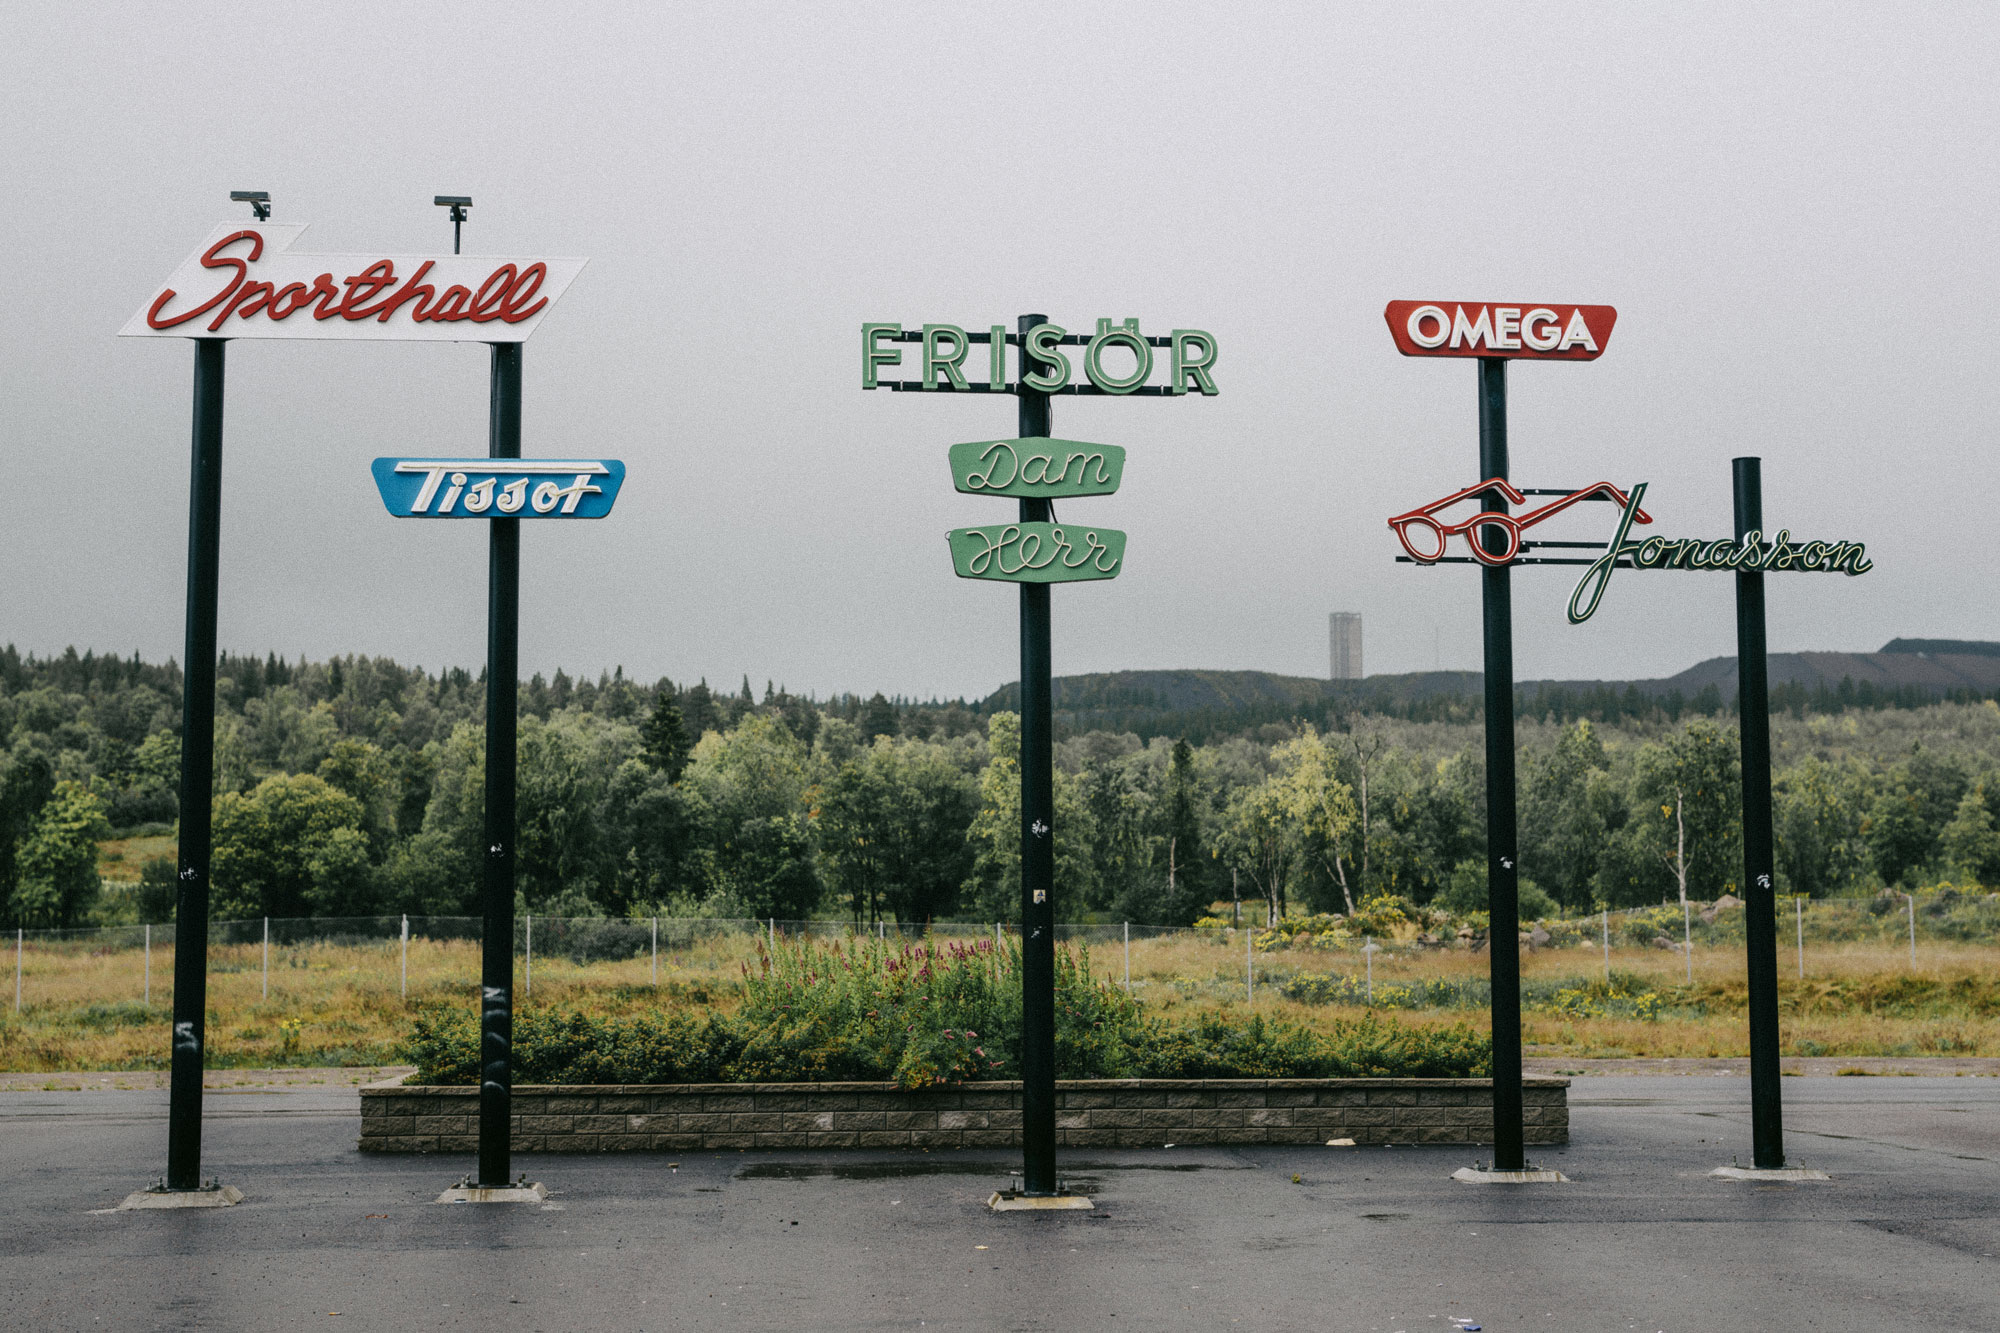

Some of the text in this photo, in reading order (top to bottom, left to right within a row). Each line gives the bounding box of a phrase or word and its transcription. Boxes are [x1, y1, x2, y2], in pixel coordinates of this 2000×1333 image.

[147, 230, 549, 332] Sporthall
[1406, 304, 1599, 352] OMEGA
[862, 317, 1220, 396] FRISÖR
[394, 461, 610, 513] Tissot
[966, 442, 1110, 489] Dam
[966, 526, 1118, 574] Herr
[1565, 481, 1874, 625] Jonasson
